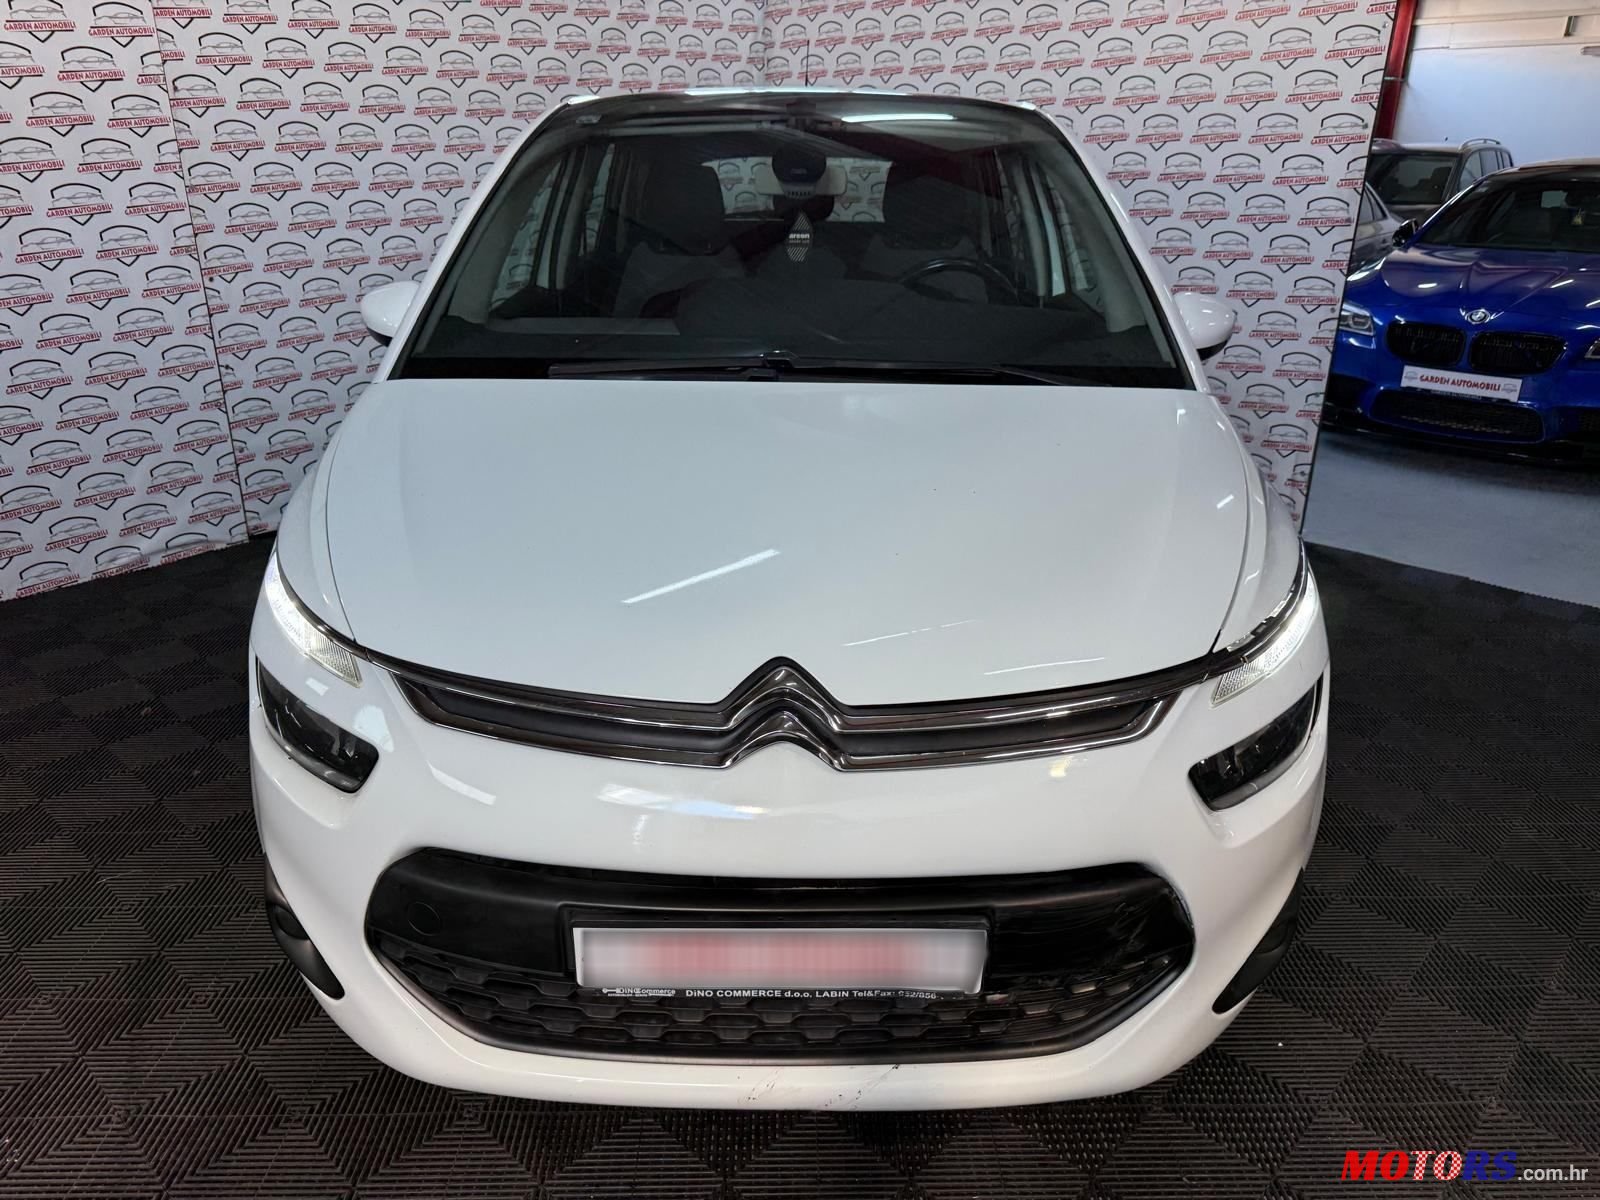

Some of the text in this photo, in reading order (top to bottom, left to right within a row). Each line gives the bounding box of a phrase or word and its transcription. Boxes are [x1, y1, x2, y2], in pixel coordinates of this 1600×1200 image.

[33, 21, 75, 30] AUTOMOBILI
[1348, 46, 1385, 56] AUTOMOBILI
[2, 67, 45, 75] AUTOMOBILI
[84, 70, 125, 79] AUTOMOBILI
[54, 115, 95, 125] AUTOMOBILI
[133, 116, 171, 126] AUTOMOBILI
[0, 160, 64, 172] ARDEN AUTOMOBILI
[103, 160, 142, 170] AUTOMOBILI
[74, 204, 112, 214] AUTOMOBILI
[43, 248, 84, 259] AUTOMOBILI
[120, 245, 160, 256] AUTOMOBILI
[92, 288, 130, 299] AUTOMOBILI
[166, 283, 201, 294] AUTOMOBILI
[137, 326, 173, 337] AUTOMOBILI
[62, 332, 101, 344] AUTOMOBILI
[110, 368, 148, 380] AUTOMOBILI
[33, 376, 72, 389] AUTOMOBILI
[1451, 379, 1501, 391] AUTOMOBILI
[81, 411, 119, 425] AUTOMOBILI
[52, 455, 91, 469] AUTOMOBILI
[98, 487, 136, 501] AUTOMOBILI
[0, 500, 61, 520] ARDEN AUTOMOBILI
[70, 530, 108, 545] AUTOMOBILI
[41, 573, 80, 590] AUTOMOBILI
[784, 990, 812, 998] d.o.o.
[816, 990, 849, 998] LABIN
